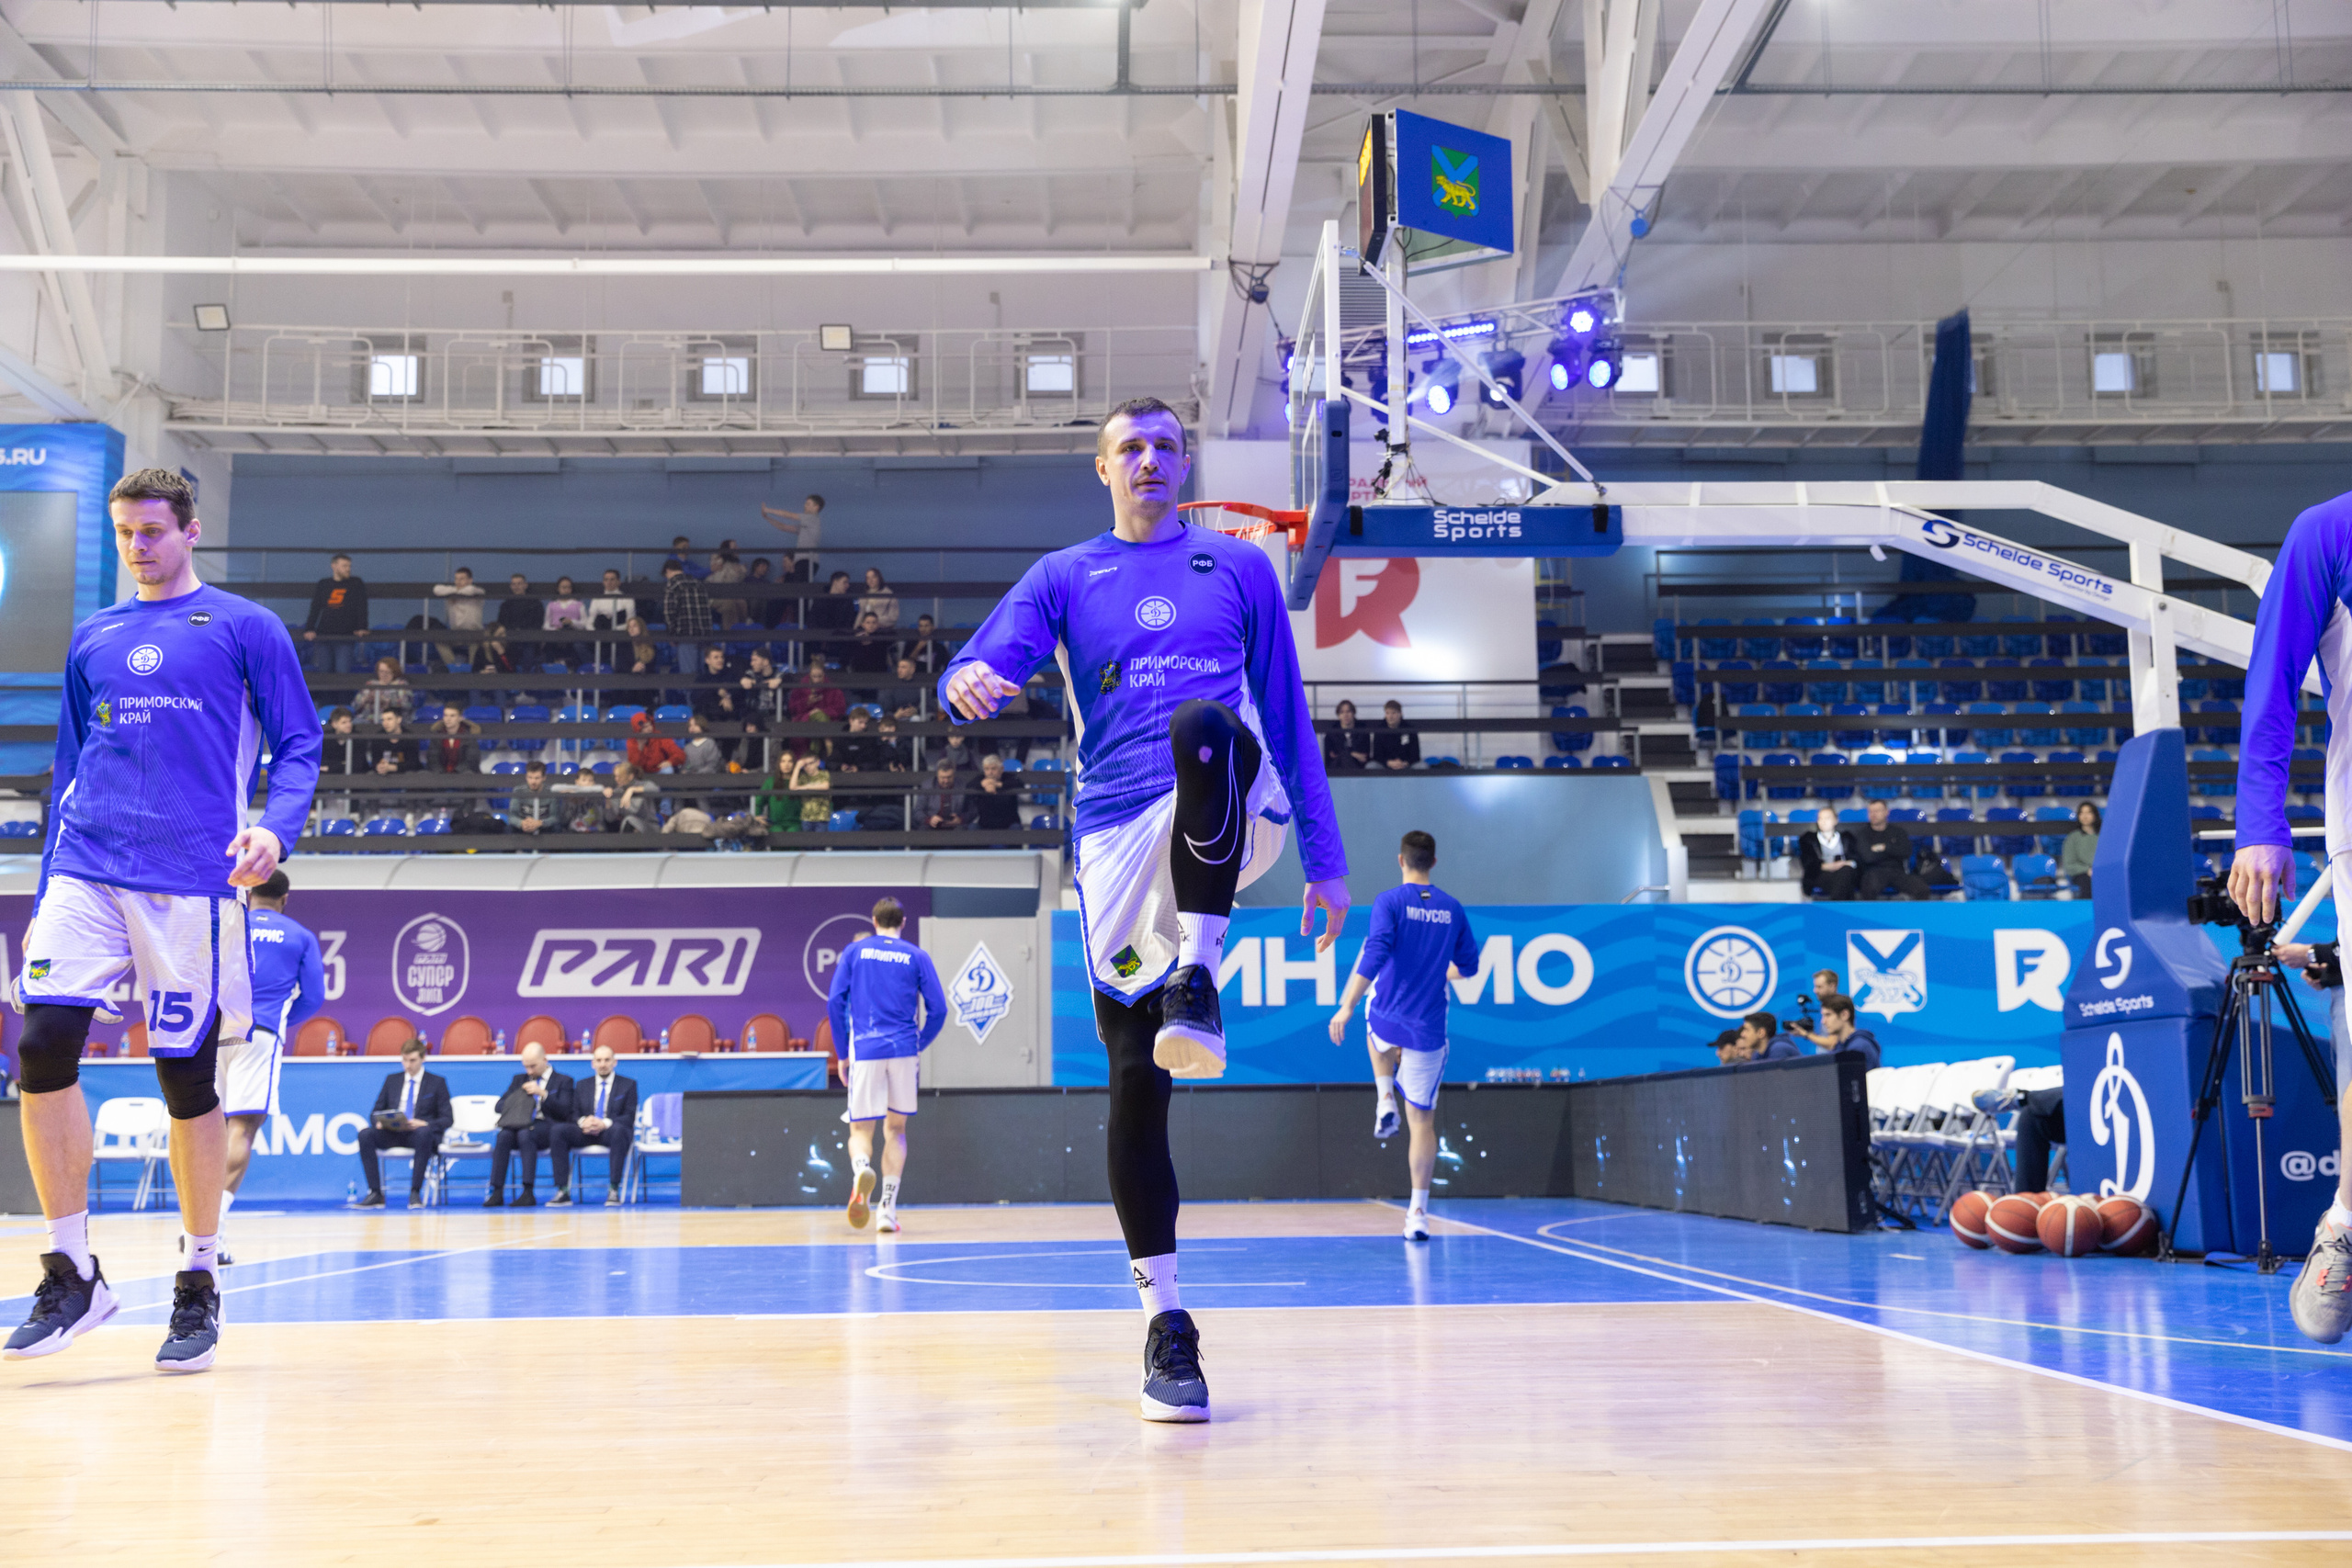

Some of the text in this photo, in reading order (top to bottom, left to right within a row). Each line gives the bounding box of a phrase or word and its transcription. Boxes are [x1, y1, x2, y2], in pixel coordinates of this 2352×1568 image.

[1433, 510, 1521, 525] Schelde
[1433, 525, 1522, 542] Sports
[1192, 559, 1214, 568] РФБ
[1962, 532, 2043, 571] Schelde
[2047, 562, 2114, 595] Sports
[1130, 654, 1221, 674] ПРИМОРСКИЙ
[1129, 670, 1166, 689] КРАЙ
[119, 695, 203, 713] ПРИМОРСКИЙ
[119, 708, 152, 725] КРАЙ
[250, 928, 285, 943] РРИС
[529, 936, 749, 987] PARI
[149, 989, 194, 1032] 15
[2115, 994, 2154, 1015] Sports
